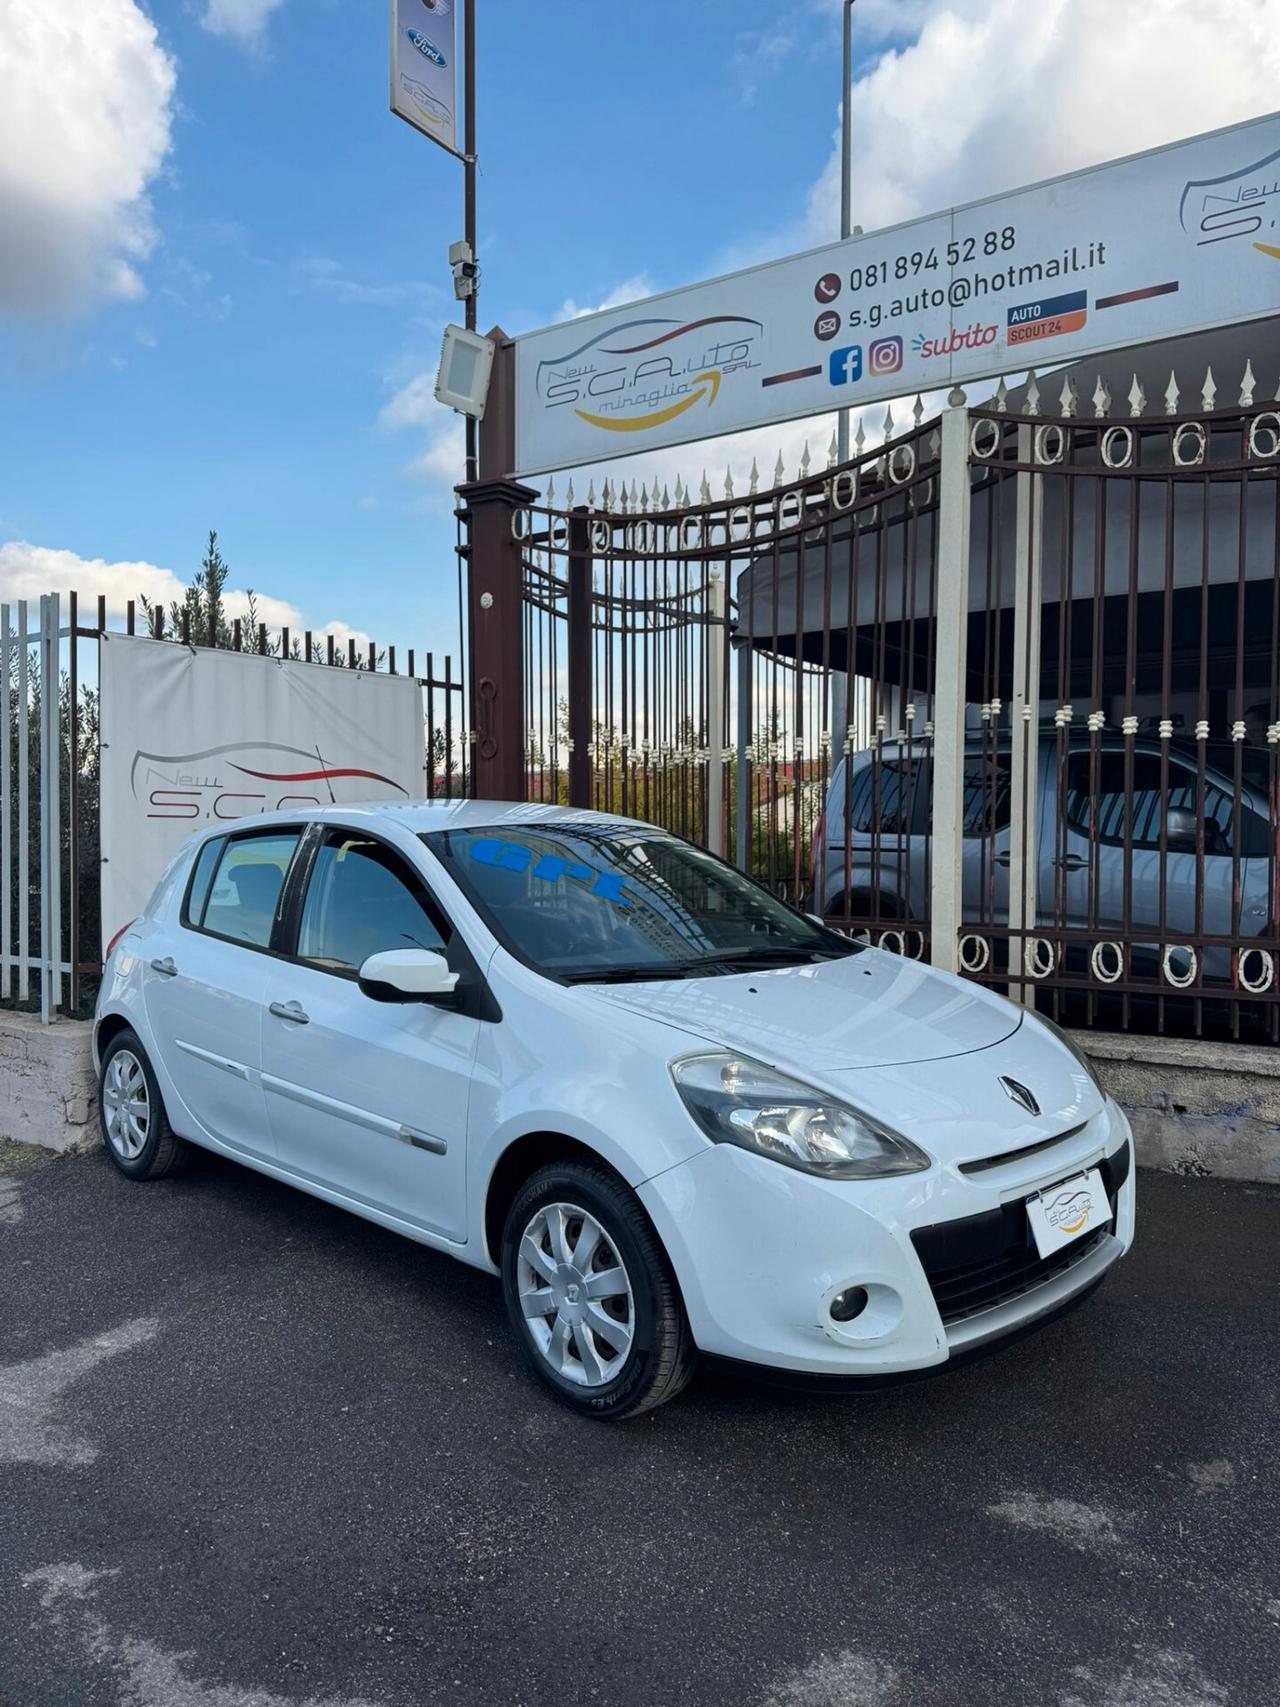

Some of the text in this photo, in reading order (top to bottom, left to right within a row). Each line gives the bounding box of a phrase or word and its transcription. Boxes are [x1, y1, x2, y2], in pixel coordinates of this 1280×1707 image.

[413, 32, 441, 63] Ford
[850, 226, 1016, 291] 081 894 52 88
[849, 242, 1106, 328] s.g.auto@hotmail.it
[1011, 304, 1041, 323] AUTO
[920, 322, 999, 359] subito
